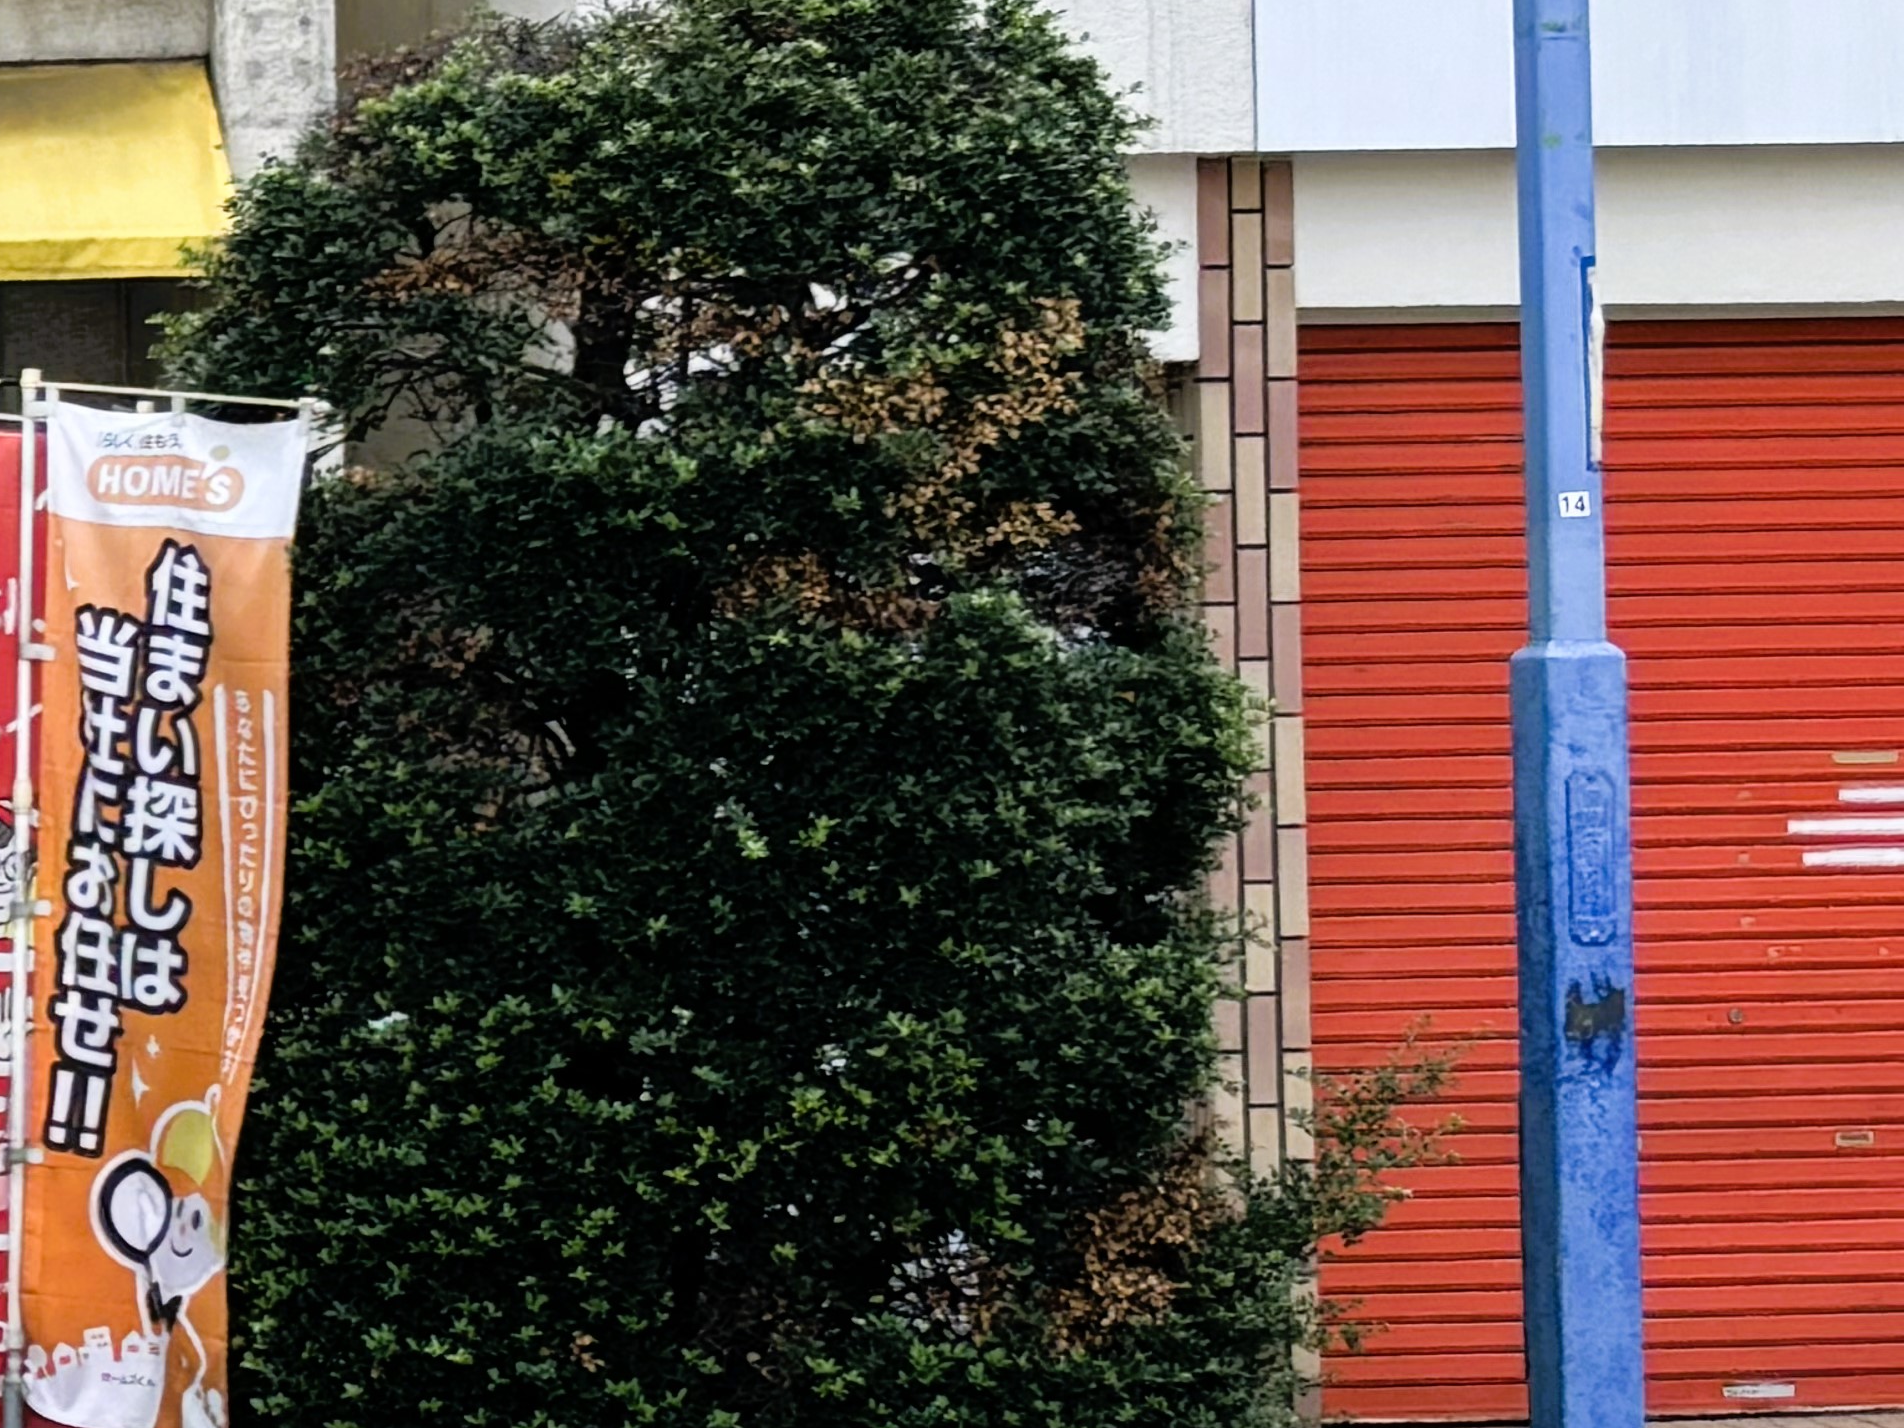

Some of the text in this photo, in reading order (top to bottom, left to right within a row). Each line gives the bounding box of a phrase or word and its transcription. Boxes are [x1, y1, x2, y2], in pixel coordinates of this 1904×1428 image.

[97, 461, 234, 507] HOME'S
[1562, 494, 1586, 513] 14
[121, 540, 211, 1012] 住まい探しは
